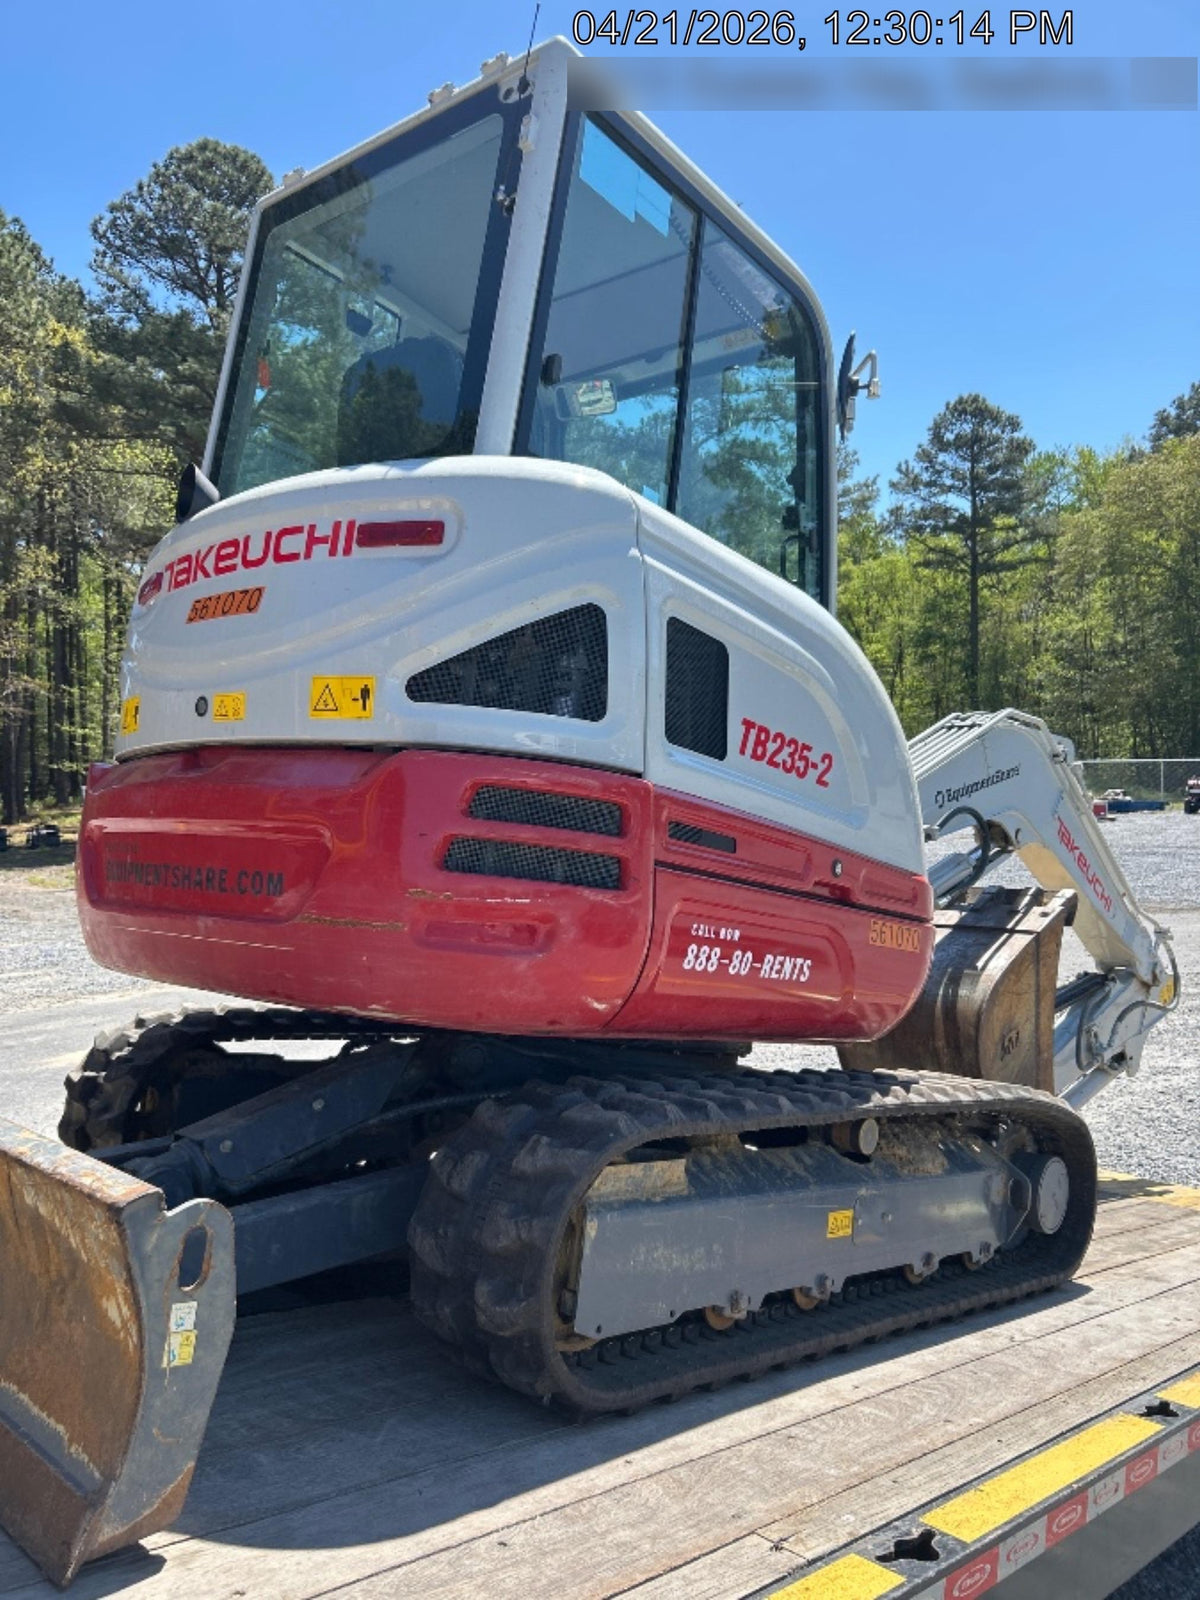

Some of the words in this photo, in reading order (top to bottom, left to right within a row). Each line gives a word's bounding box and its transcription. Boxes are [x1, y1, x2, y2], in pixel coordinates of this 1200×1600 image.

[188, 588, 263, 621] 561070
[738, 717, 833, 788] TB235-2
[691, 923, 716, 939] CALL
[870, 923, 919, 950] 561070
[682, 943, 812, 983] 888-80-RENTS
